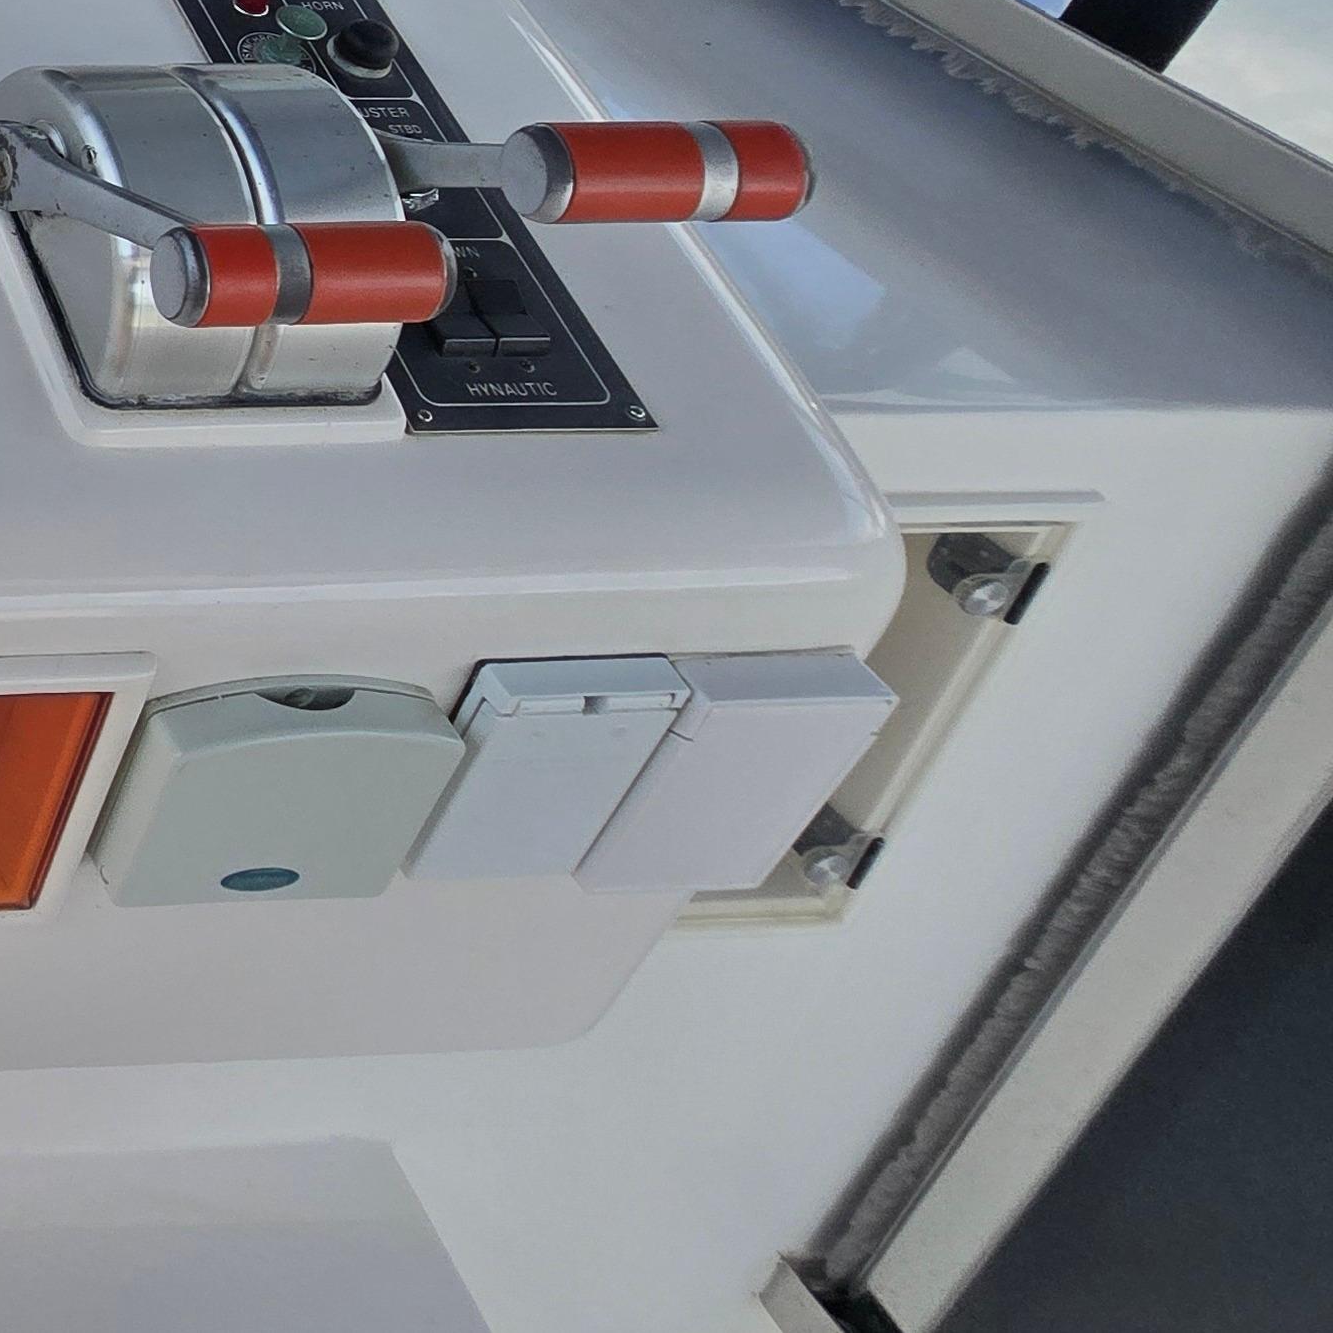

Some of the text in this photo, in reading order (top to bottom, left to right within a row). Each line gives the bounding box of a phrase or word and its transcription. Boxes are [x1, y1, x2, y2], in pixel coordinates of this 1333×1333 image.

[301, 1, 344, 11] HORN
[358, 106, 411, 119] USTER
[388, 124, 423, 134] STBD
[465, 382, 558, 397] HYNAUTIC
